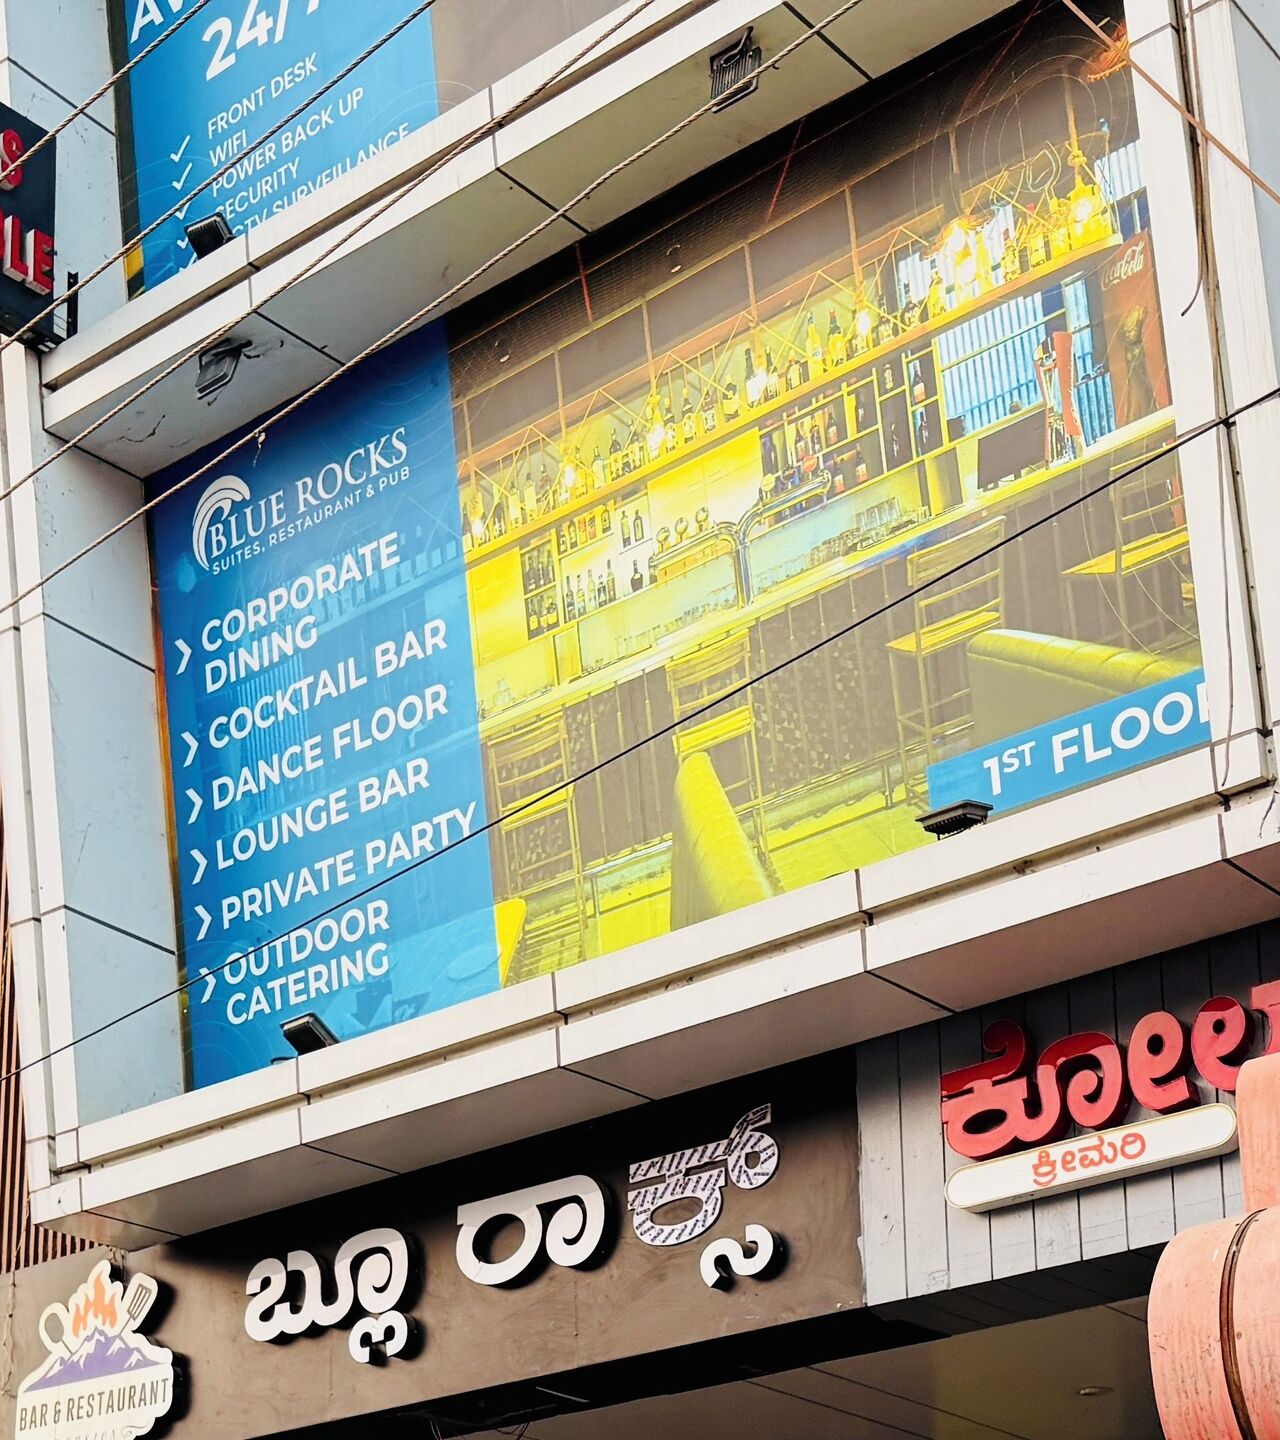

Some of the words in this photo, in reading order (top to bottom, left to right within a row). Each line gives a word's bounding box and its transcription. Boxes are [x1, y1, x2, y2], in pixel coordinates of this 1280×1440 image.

[202, 0, 320, 81] 24/
[207, 86, 267, 139] FRONT
[271, 53, 319, 98] DESK
[209, 130, 249, 168] WIFI
[212, 143, 276, 197] POWER
[281, 106, 336, 151] BACK
[338, 87, 365, 118] UP
[214, 157, 300, 222] SECURITY
[208, 489, 287, 559] BLUE
[295, 427, 408, 514] ROCKS
[212, 543, 266, 576] SUITES,
[269, 490, 362, 547] RESTAURANT
[365, 484, 376, 499] &
[378, 466, 411, 492] PUB
[200, 531, 401, 655] CORPORATE
[204, 614, 319, 695] DINING
[208, 650, 369, 750] COCKTAIL
[376, 617, 448, 682] BAR
[211, 738, 325, 812] DANCE
[333, 682, 449, 760] FLOOR
[983, 741, 1037, 796] 1ST
[216, 788, 351, 871] LOUNGE
[360, 755, 431, 811] BAR
[222, 854, 356, 931] PRIVATE
[365, 801, 478, 884] PARTY
[224, 899, 391, 987] OUTDOOR
[226, 944, 391, 1027] CATERING
[19, 1403, 48, 1432] BAR
[53, 1400, 62, 1425] &
[66, 1377, 169, 1422] RESTAURANT
